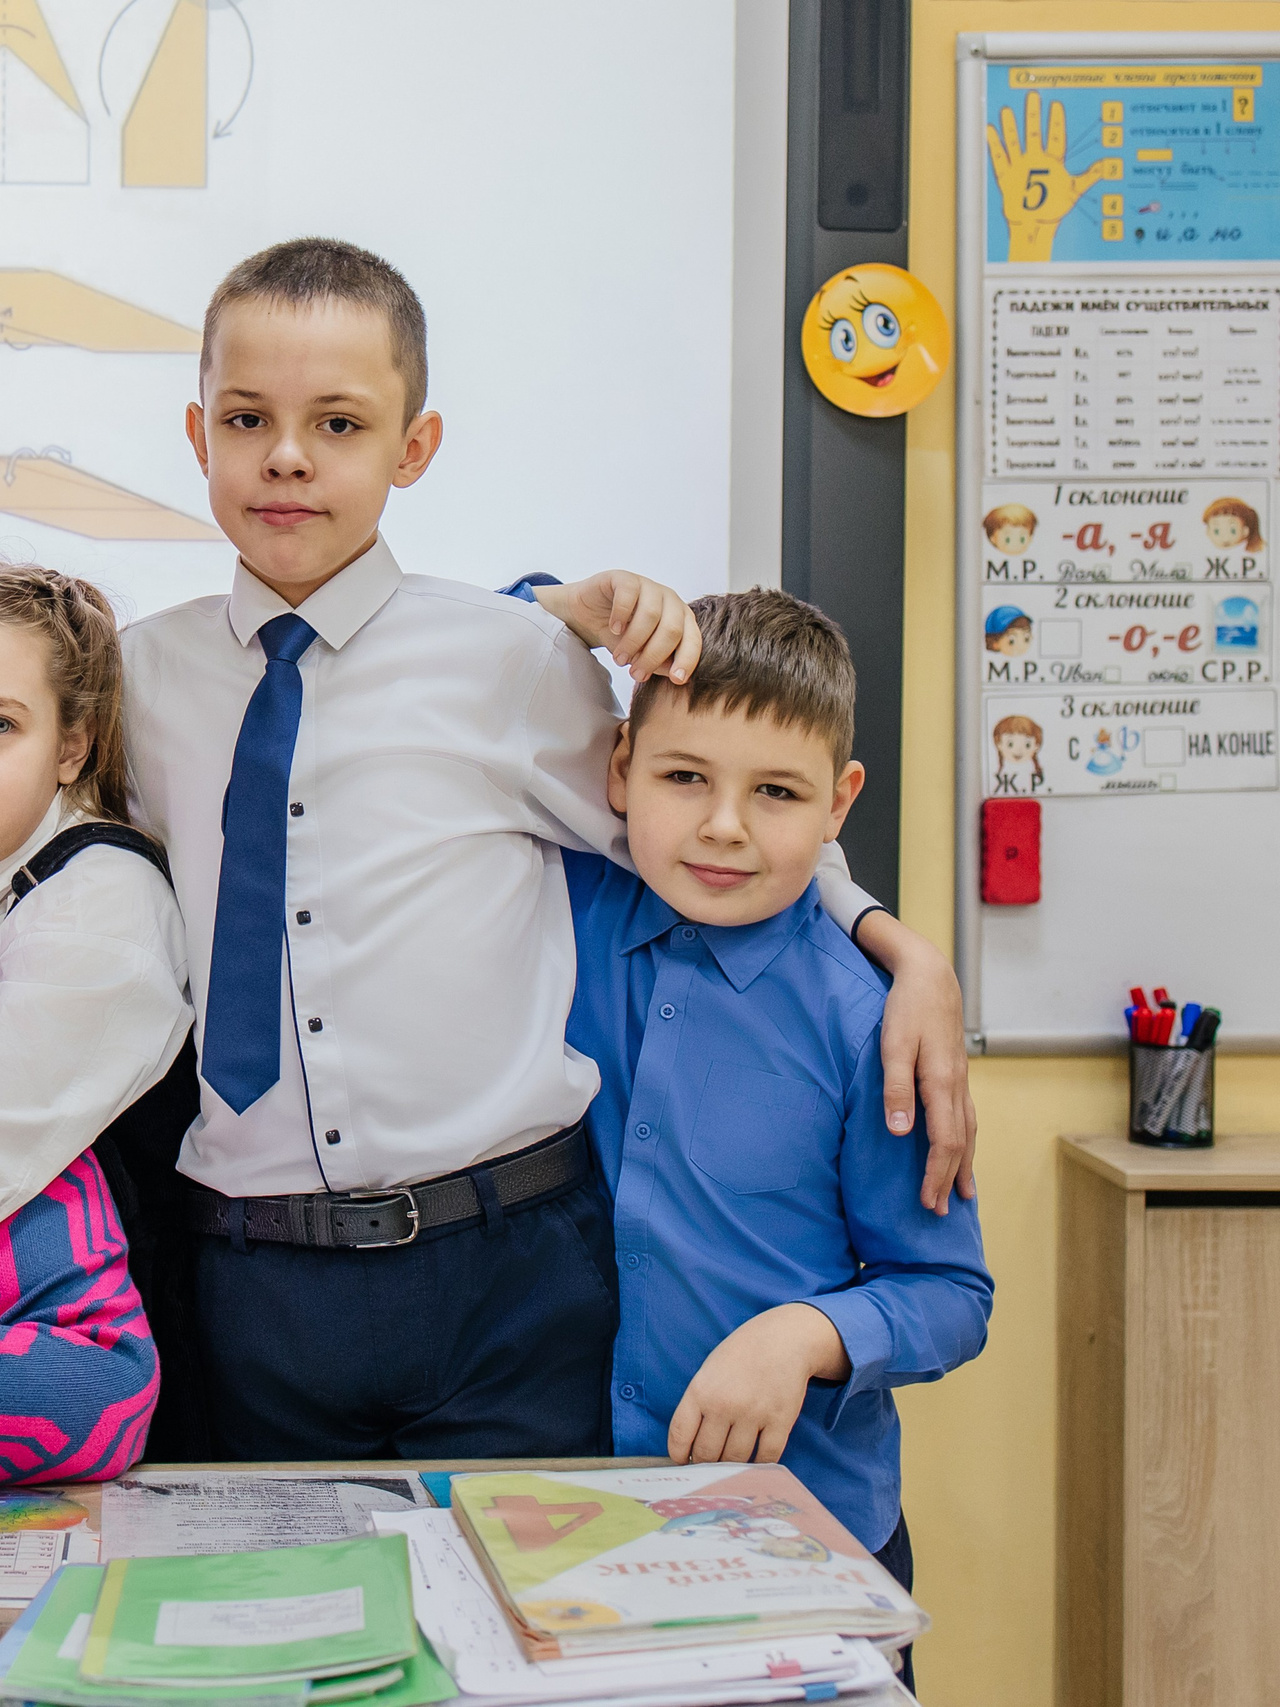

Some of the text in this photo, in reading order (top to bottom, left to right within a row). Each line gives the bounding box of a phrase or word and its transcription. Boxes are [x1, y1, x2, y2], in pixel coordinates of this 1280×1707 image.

[1022, 168, 1050, 211] 5
[1010, 301, 1074, 313] ПАДЕЖИ
[1068, 488, 1189, 506] склонение
[986, 559, 1045, 580] М.Р.
[1204, 556, 1265, 580] Ж.Р.
[1054, 586, 1195, 609] 2 склонение
[987, 660, 1046, 683] М.Р.
[1060, 695, 1201, 718] 3 склонение
[1188, 733, 1213, 756] НА
[1216, 730, 1276, 757] КОНЦЕ
[482, 1496, 605, 1553] 4
